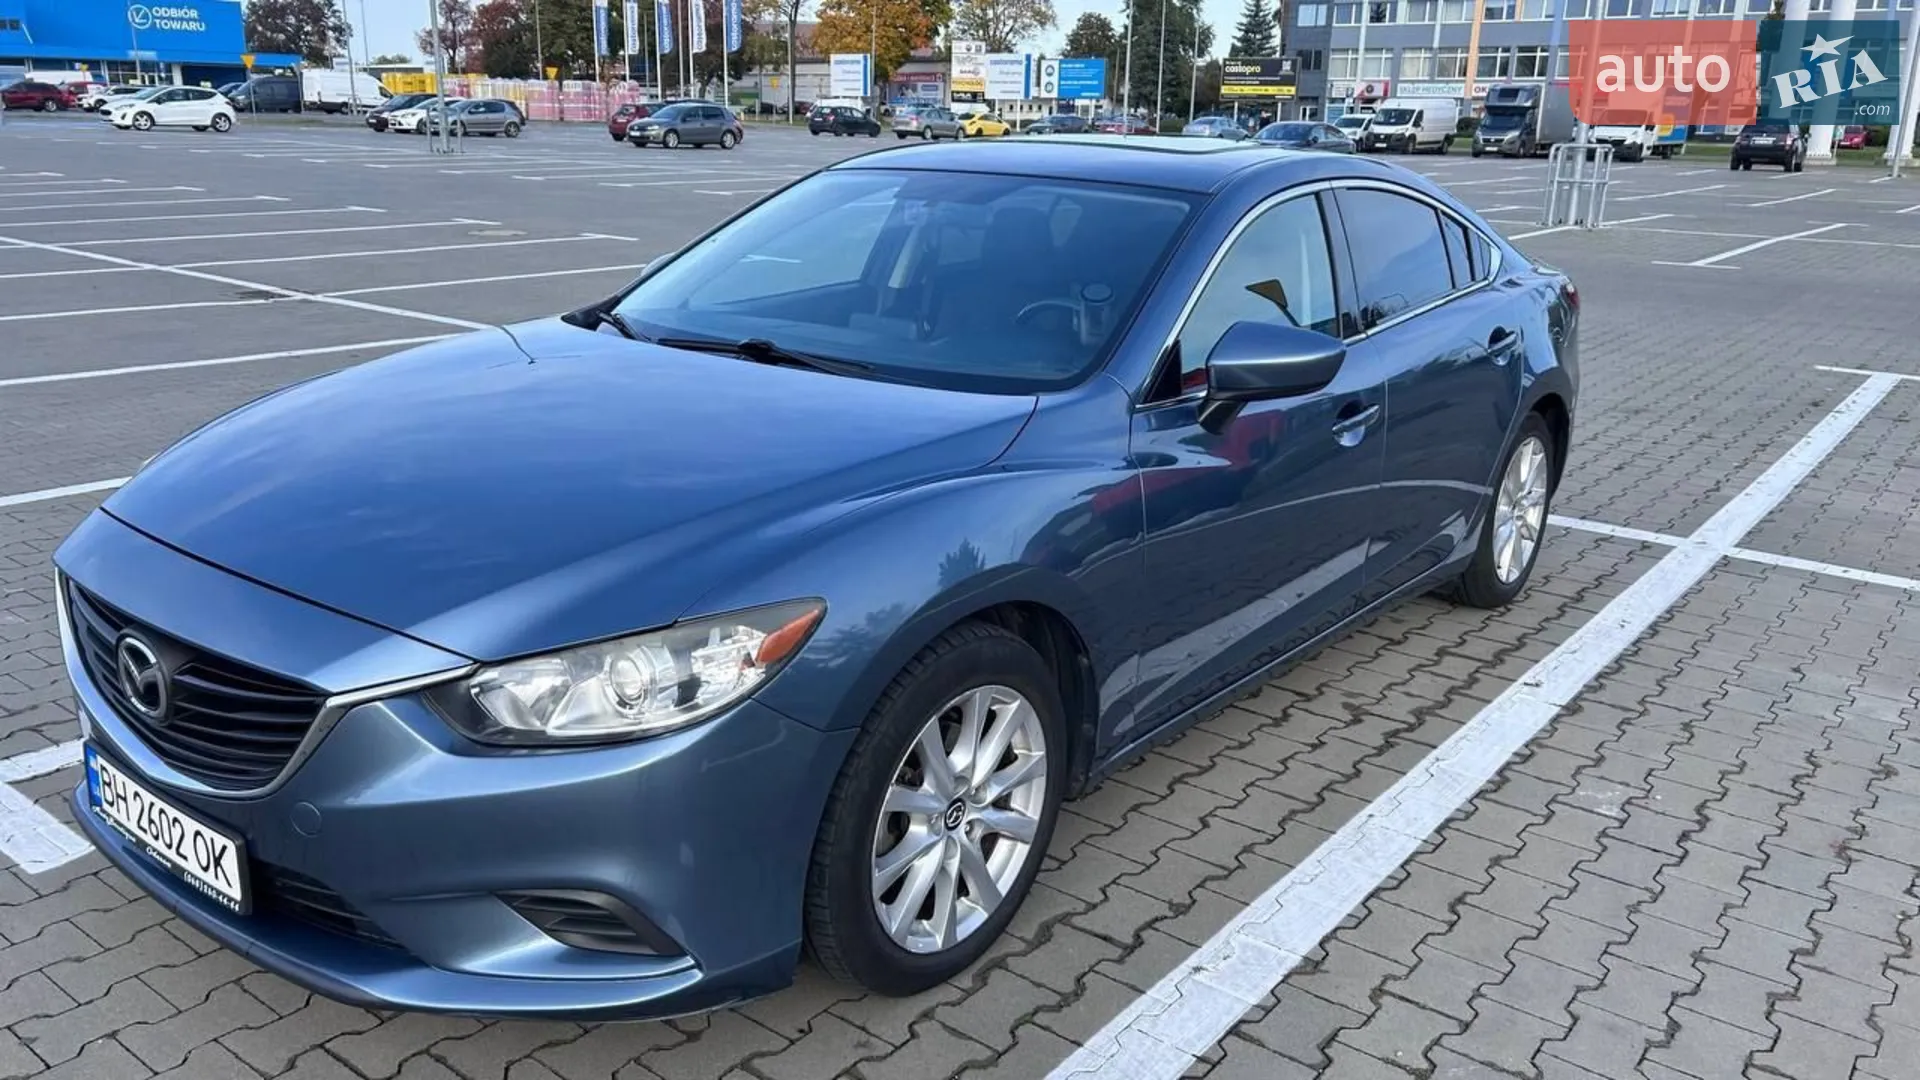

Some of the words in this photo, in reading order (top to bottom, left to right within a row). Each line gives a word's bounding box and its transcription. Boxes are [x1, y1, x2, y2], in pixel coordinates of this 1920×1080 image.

[152, 6, 198, 18] ODBIÓR
[154, 19, 206, 31] TOWARU
[1225, 64, 1261, 76] castopro
[100, 764, 131, 822] BH
[133, 790, 189, 862] 2602
[193, 830, 233, 889] OK
